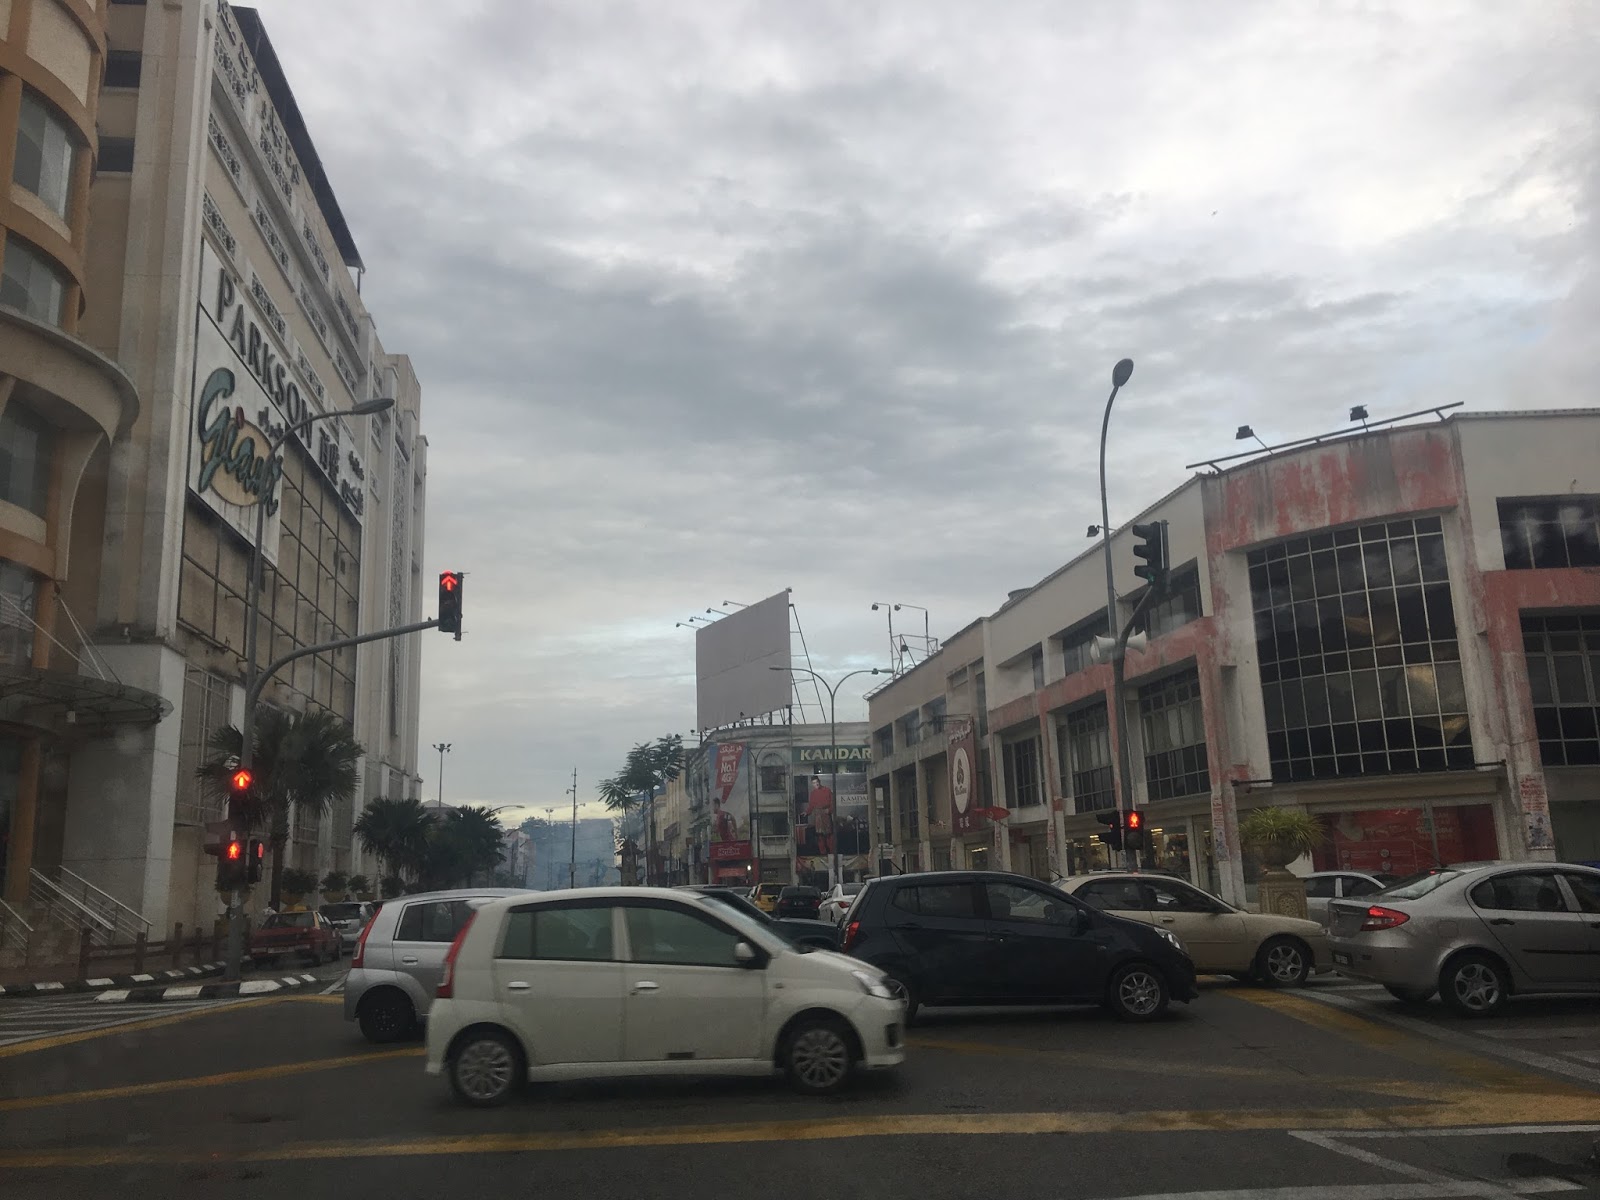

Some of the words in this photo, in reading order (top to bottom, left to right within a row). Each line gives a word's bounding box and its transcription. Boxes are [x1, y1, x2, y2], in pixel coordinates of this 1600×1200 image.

[217, 268, 314, 450] PARKSON
[199, 367, 284, 518] Giant
[800, 748, 872, 761] KAMDAR
